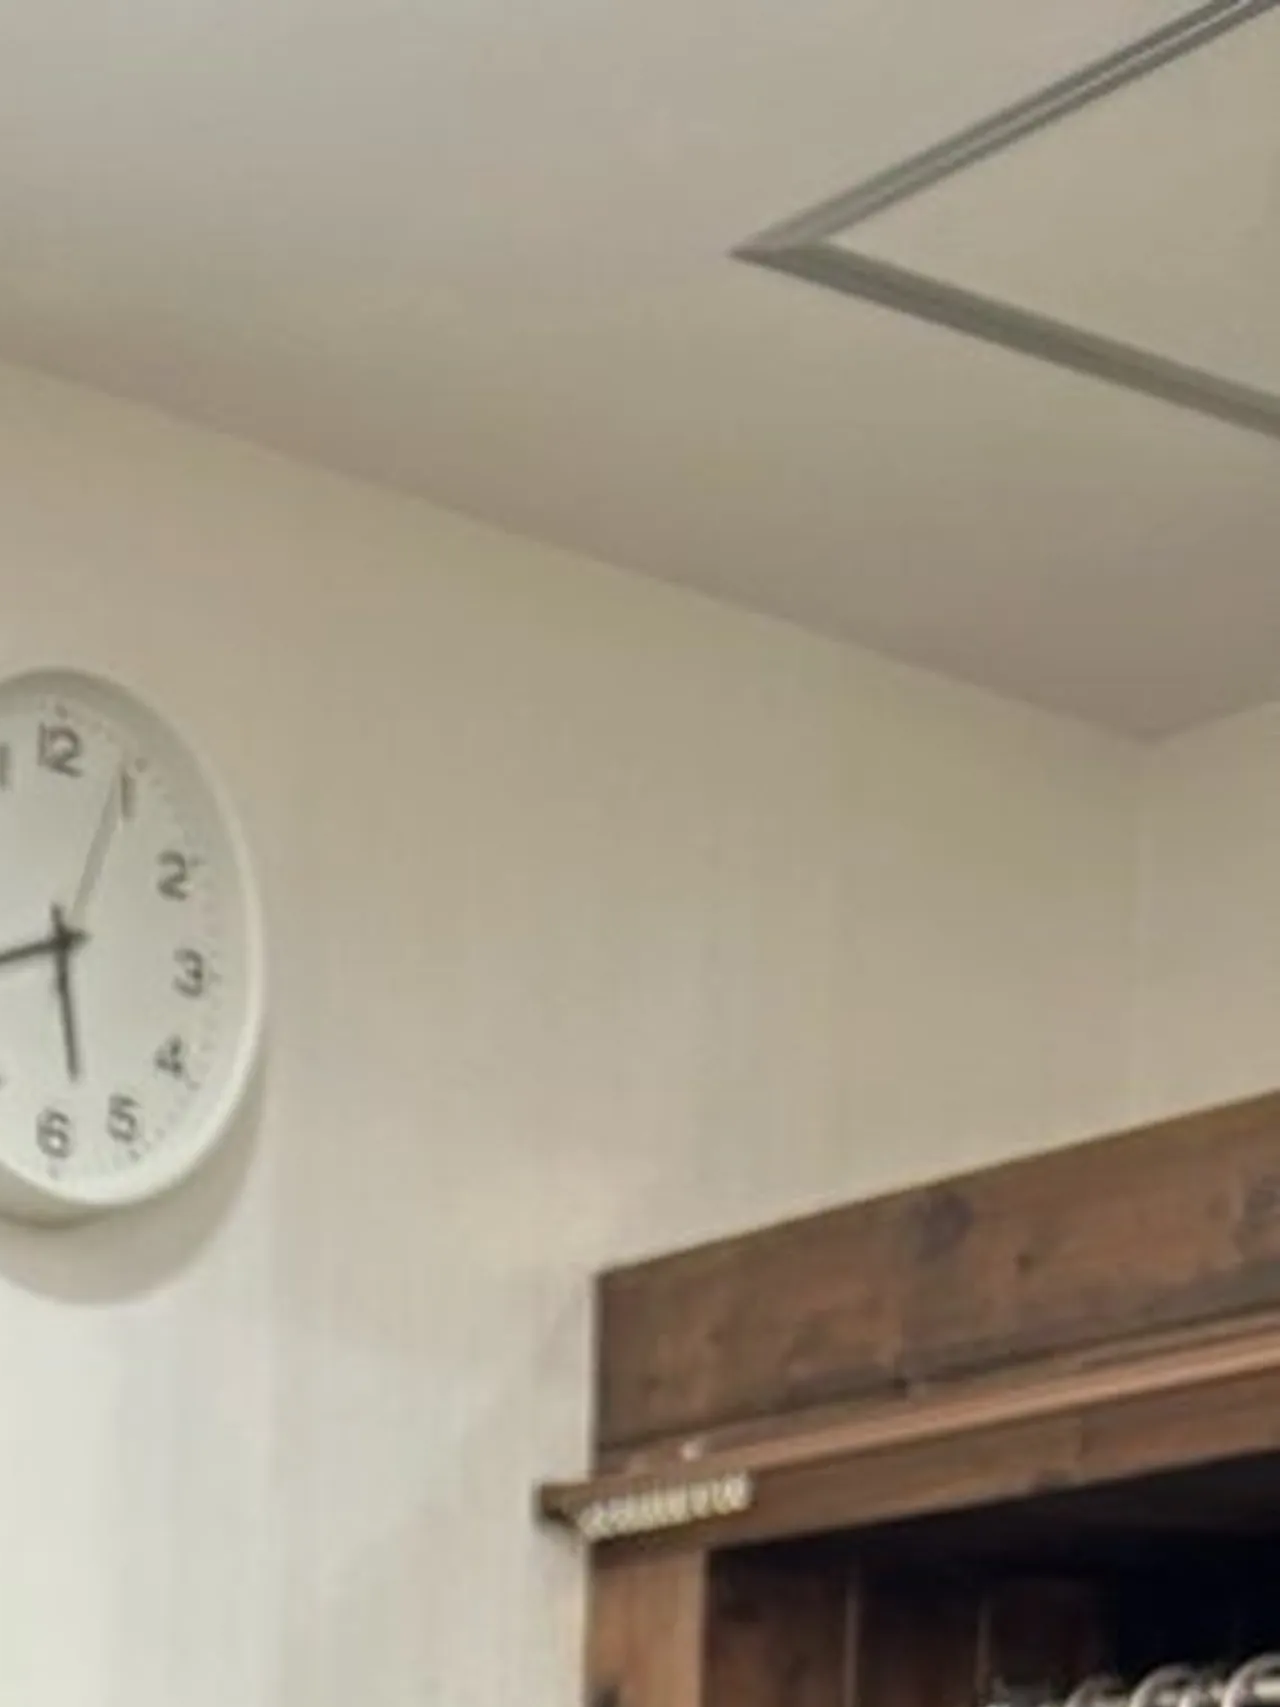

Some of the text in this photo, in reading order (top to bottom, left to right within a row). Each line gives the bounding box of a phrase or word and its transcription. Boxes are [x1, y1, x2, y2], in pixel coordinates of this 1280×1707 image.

[37, 722, 83, 778] 12
[156, 852, 188, 901] 2
[174, 950, 204, 997] 3
[153, 1036, 184, 1077] 4
[37, 1108, 72, 1159] 6
[107, 1094, 140, 1143] 5
